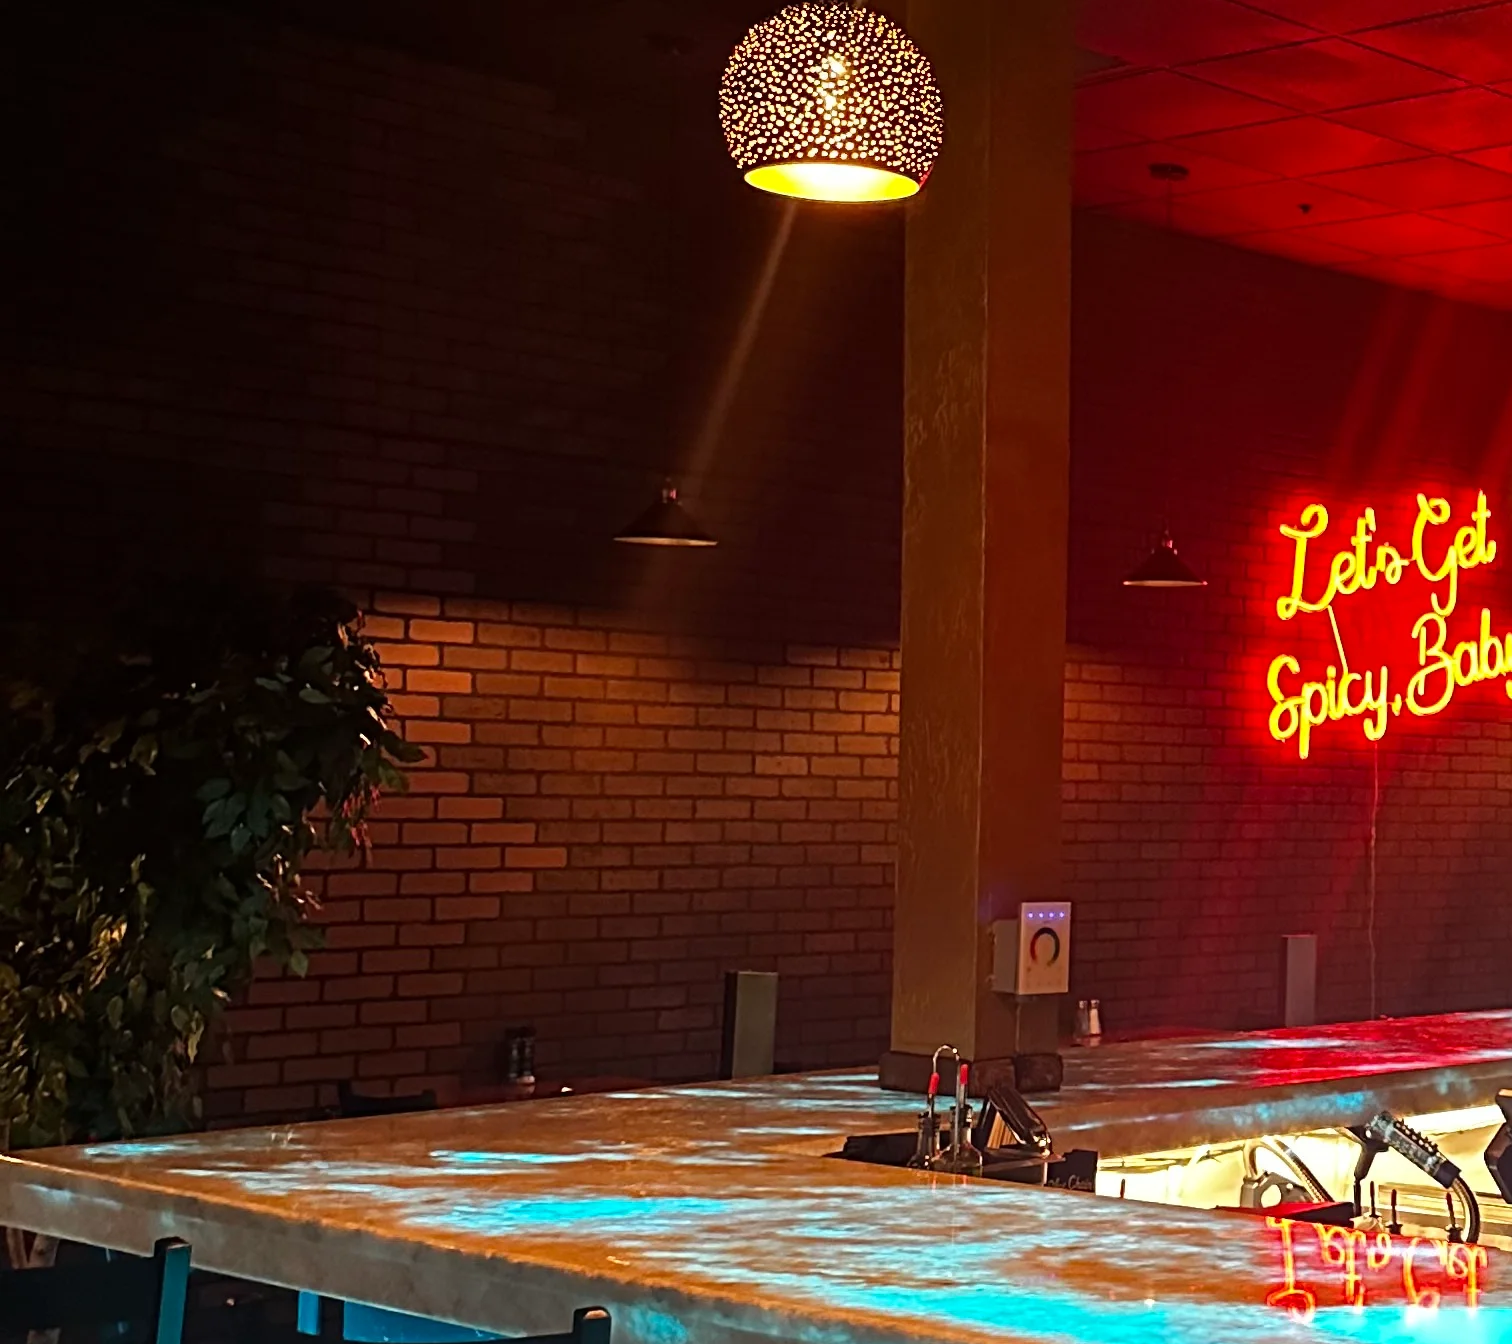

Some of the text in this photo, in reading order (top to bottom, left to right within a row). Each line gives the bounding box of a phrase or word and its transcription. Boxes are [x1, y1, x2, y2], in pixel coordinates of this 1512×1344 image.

[1276, 489, 1497, 621] Let's Get
[1266, 653, 1402, 760] Spicy,
